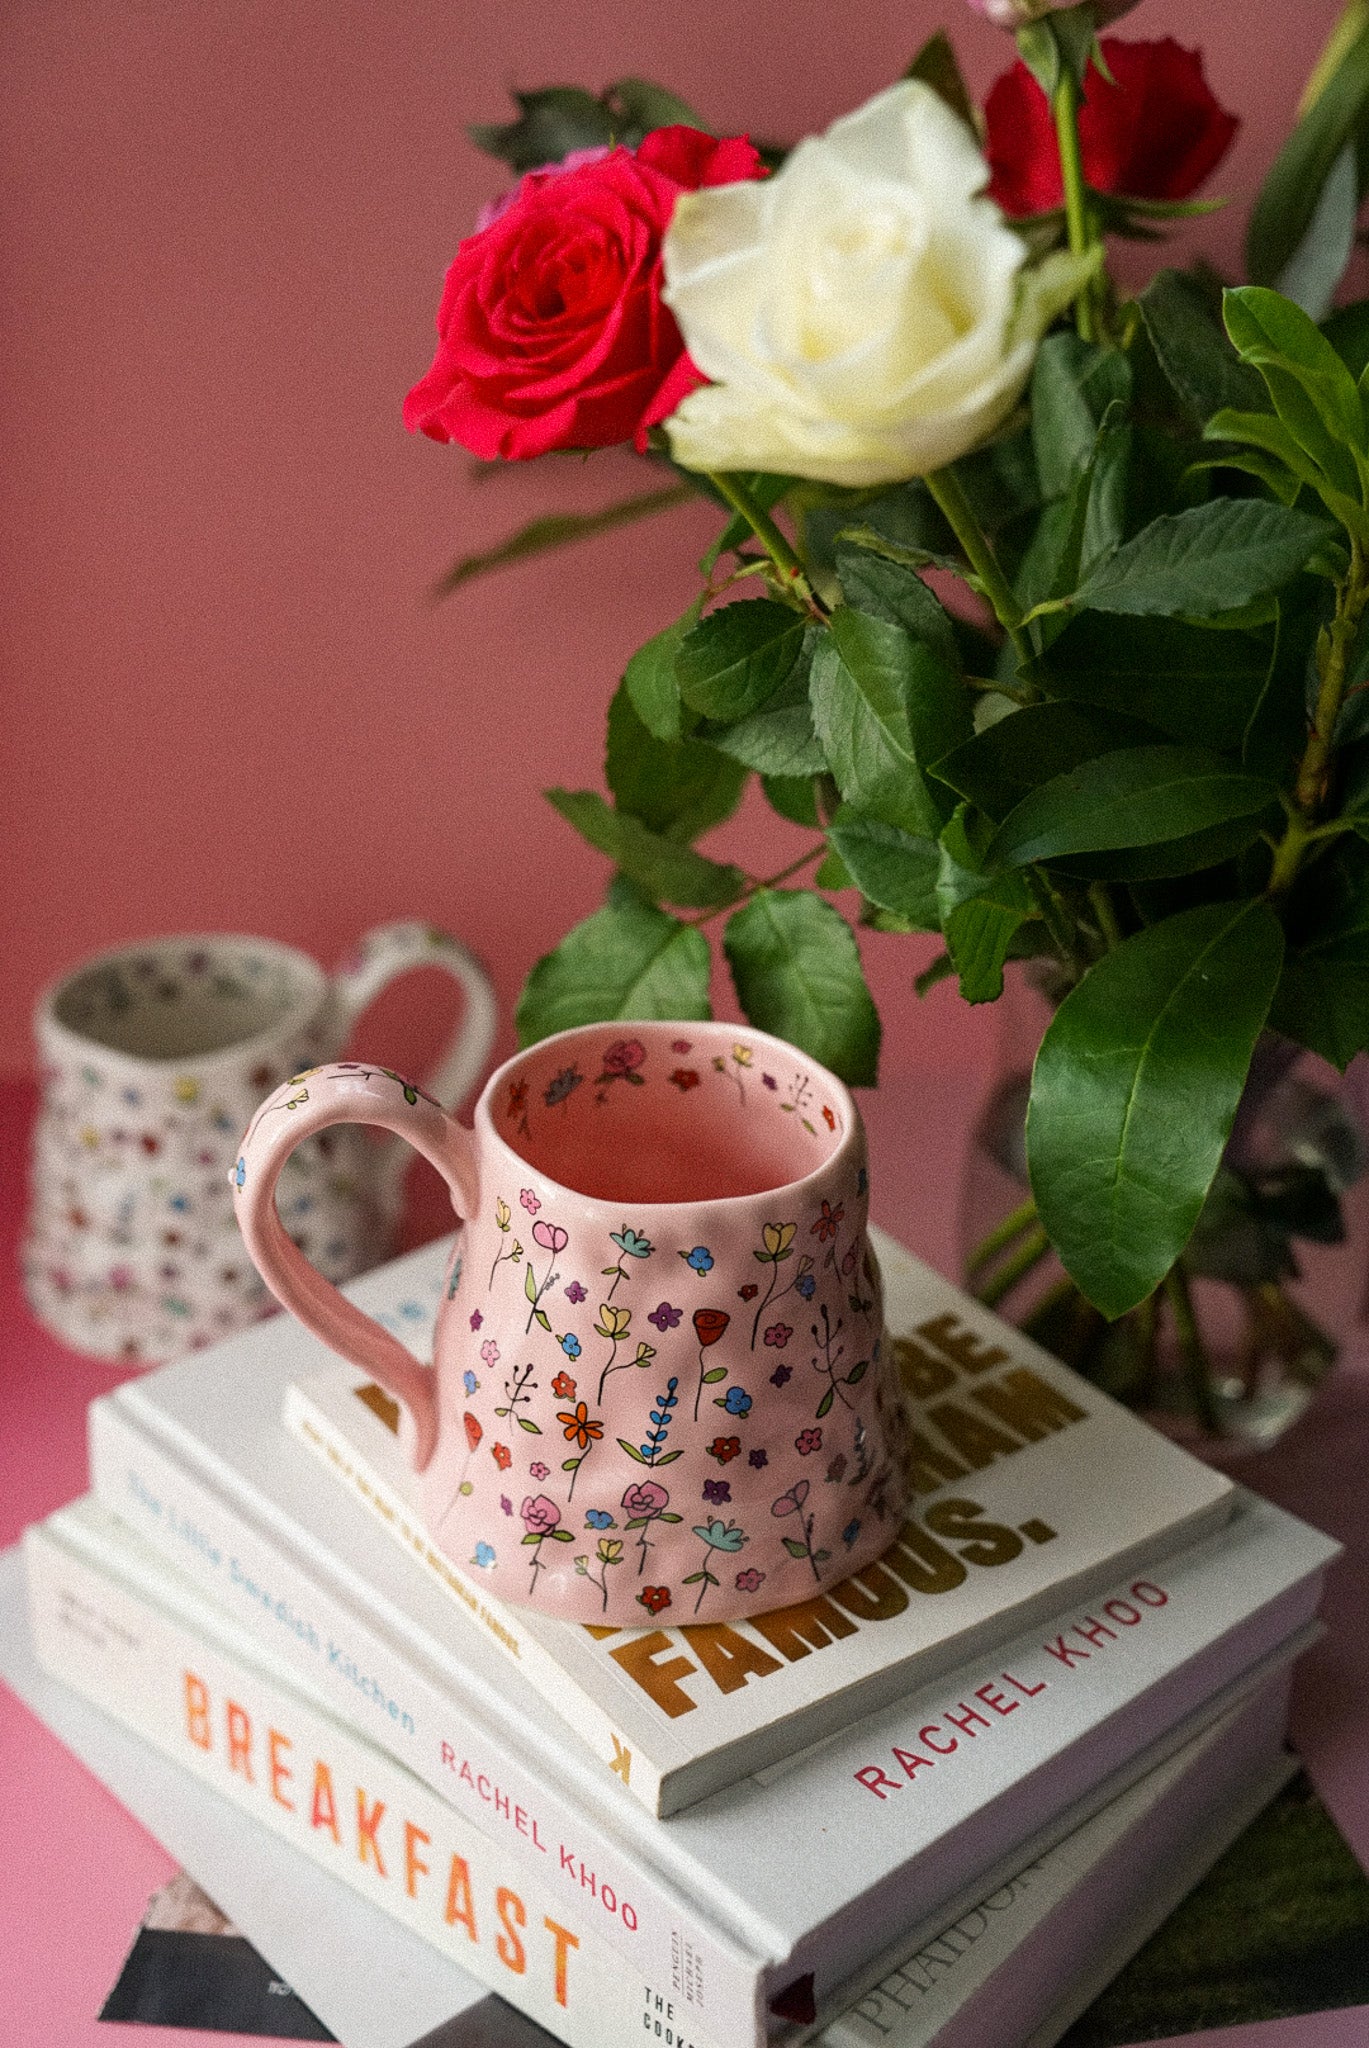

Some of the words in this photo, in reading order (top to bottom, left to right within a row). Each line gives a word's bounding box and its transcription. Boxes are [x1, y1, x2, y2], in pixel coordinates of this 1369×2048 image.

[608, 1498, 1058, 1719] FAMOUS.
[853, 1672, 1047, 1800] RACHEL
[1043, 1580, 1169, 1679] KHOO
[183, 1667, 582, 2009] BREAKFAST
[440, 1740, 547, 1853] RACHEL
[559, 1844, 639, 1931] KHOO
[644, 1985, 675, 2021] THE
